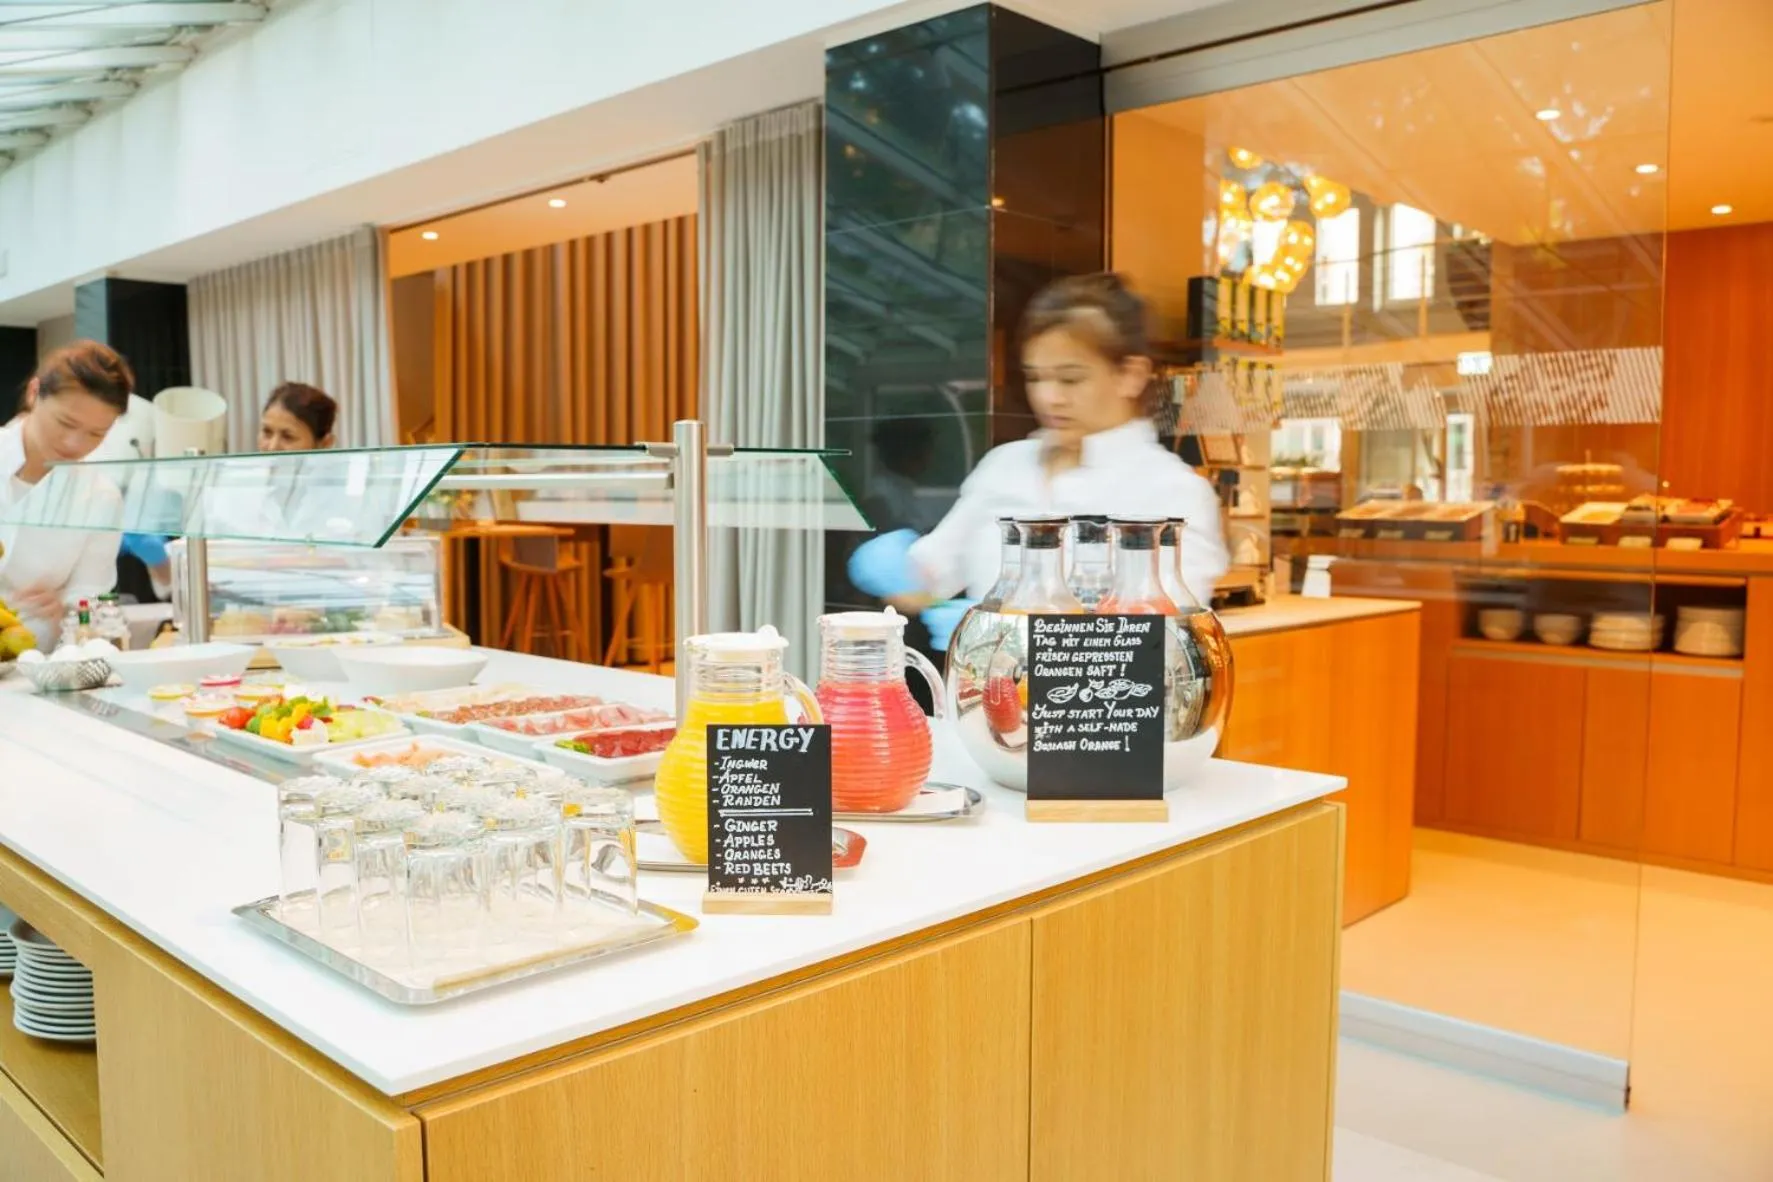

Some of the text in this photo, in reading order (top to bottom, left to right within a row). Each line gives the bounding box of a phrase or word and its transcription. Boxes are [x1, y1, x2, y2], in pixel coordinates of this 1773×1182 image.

[1033, 634, 1057, 647] TAG
[1067, 709, 1104, 719] START
[1135, 706, 1160, 718] DAY
[716, 728, 815, 753] ENERGY
[753, 863, 792, 876] BEETS
